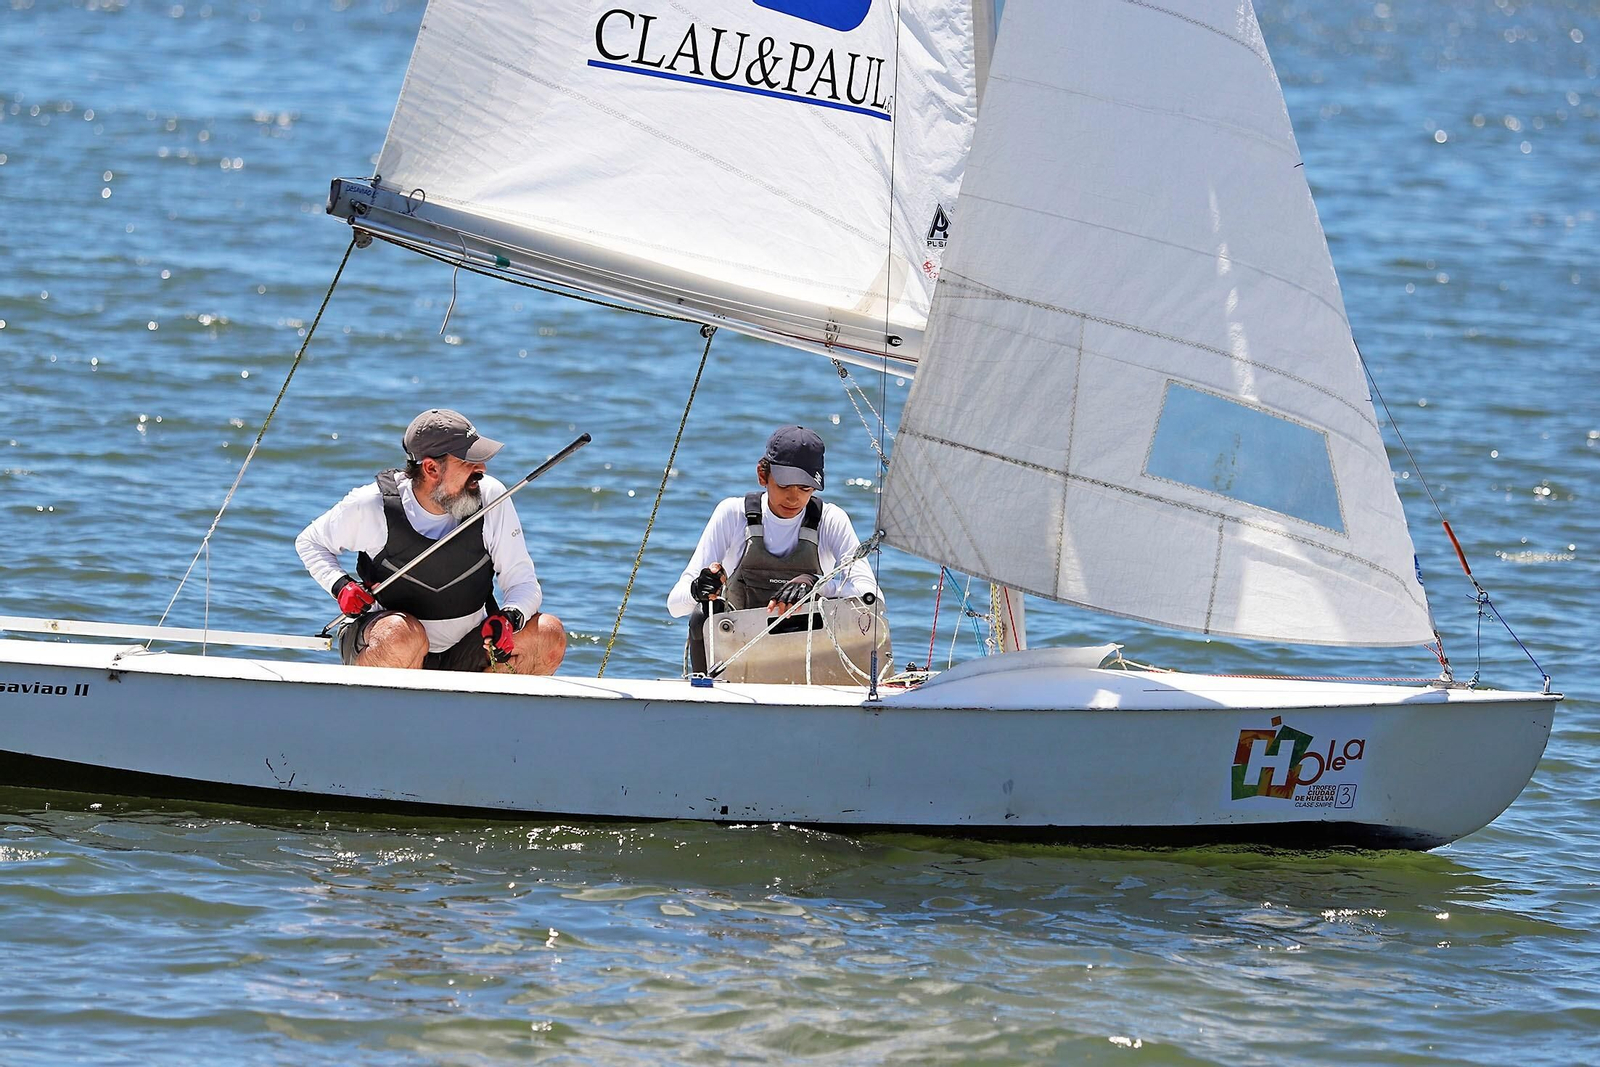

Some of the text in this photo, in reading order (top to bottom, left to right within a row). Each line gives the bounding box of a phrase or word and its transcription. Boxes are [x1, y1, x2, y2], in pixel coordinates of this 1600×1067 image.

[595, 9, 886, 109] CLAU&PAUL
[74, 683, 89, 696] II
[1339, 786, 1351, 805] 3
